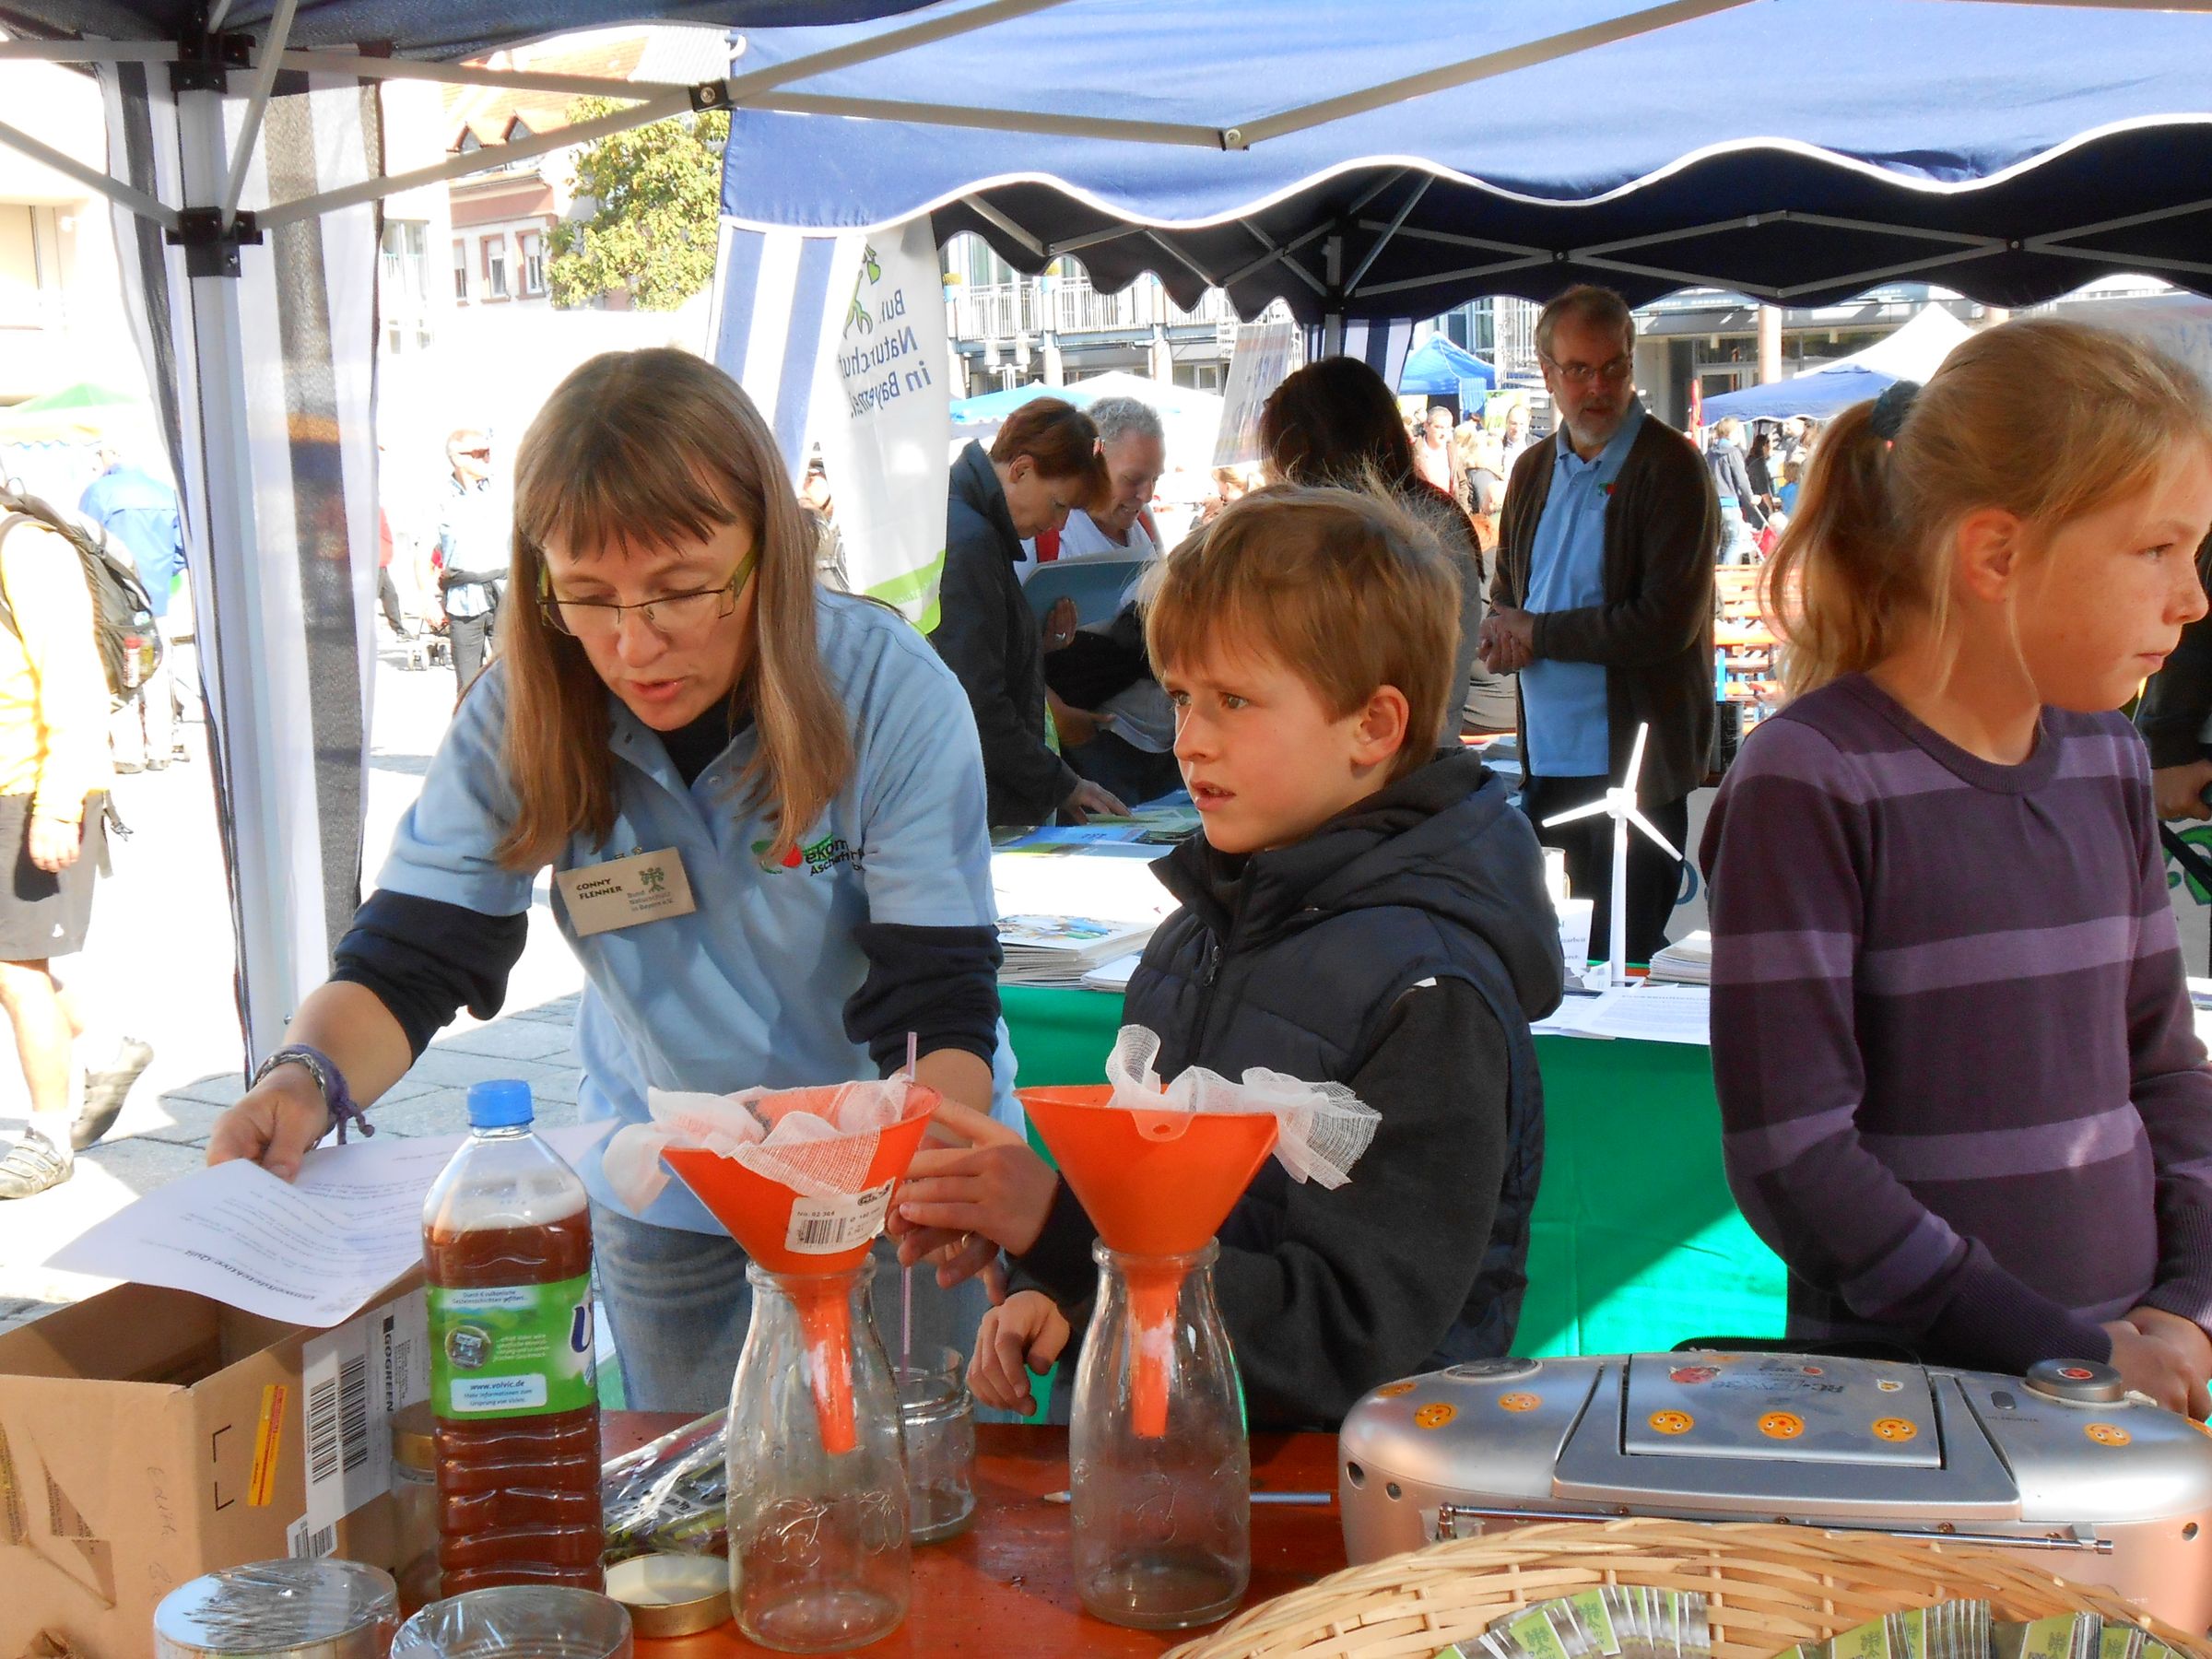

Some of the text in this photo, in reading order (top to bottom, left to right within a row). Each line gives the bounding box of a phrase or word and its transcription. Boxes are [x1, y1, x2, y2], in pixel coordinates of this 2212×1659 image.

[576, 878, 611, 891] CONNY
[579, 885, 623, 900] FLENNER
[383, 1333, 394, 1412] GOGREEN
[470, 1380, 525, 1391] www.volvic.de
